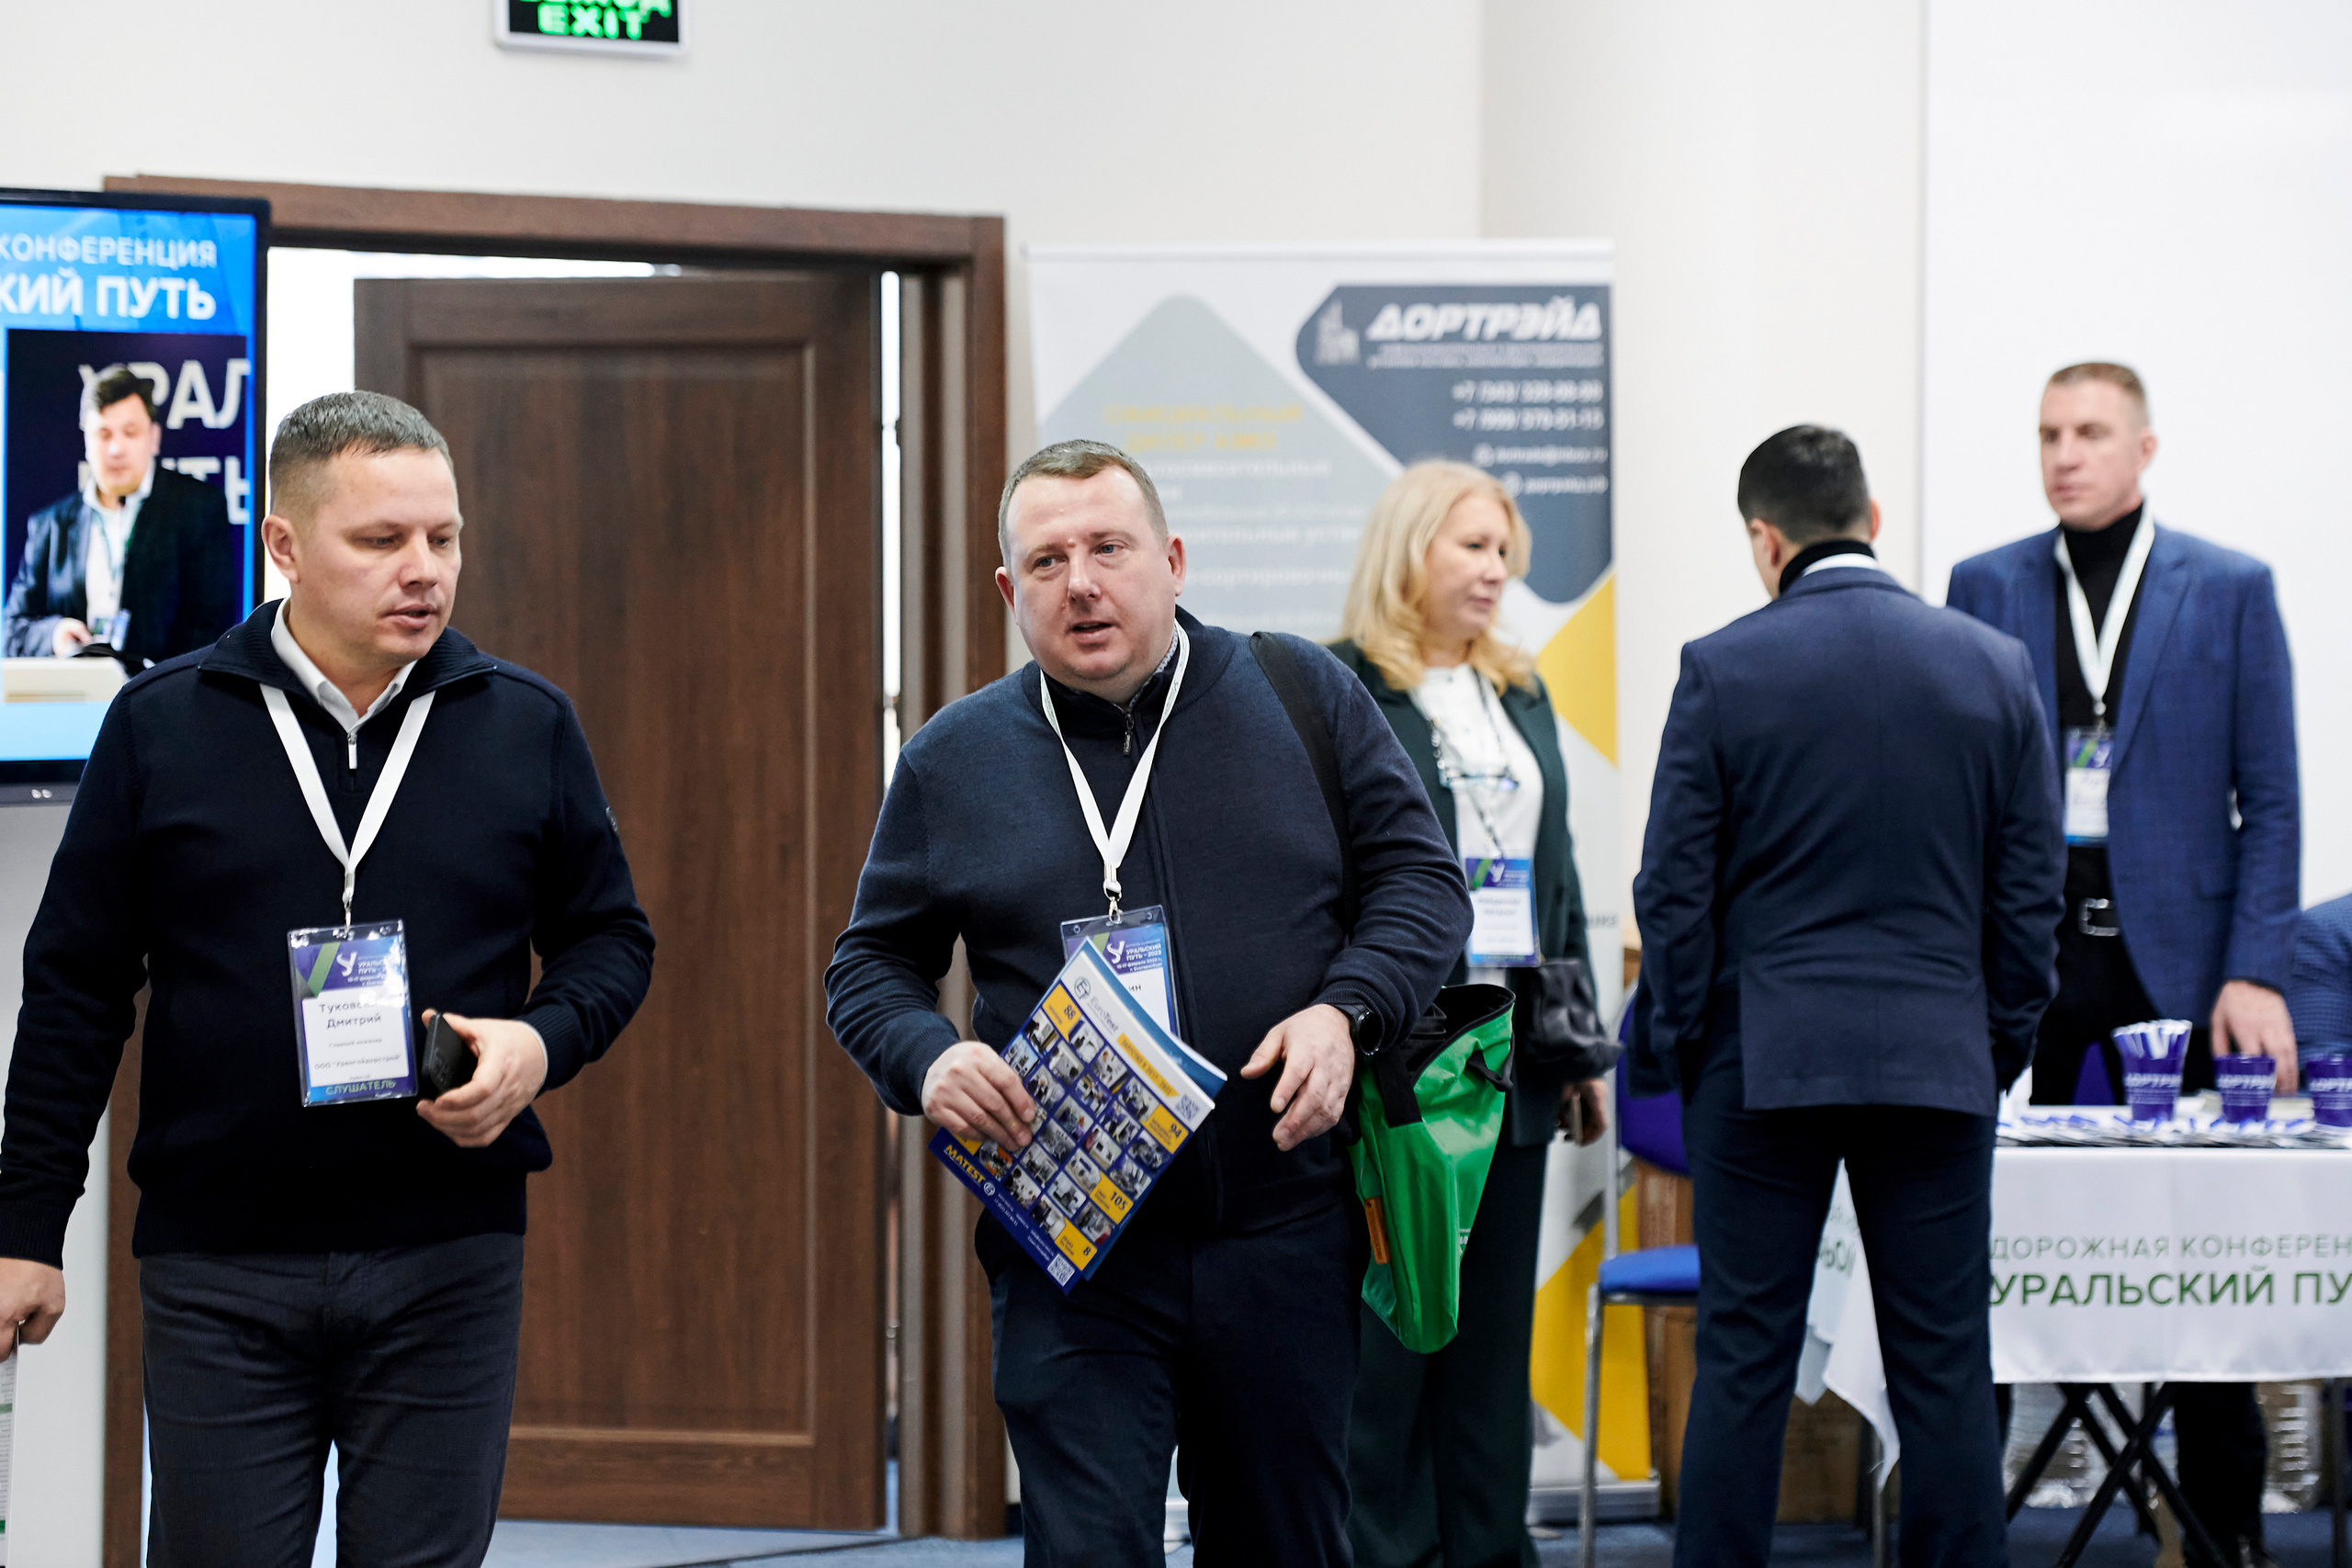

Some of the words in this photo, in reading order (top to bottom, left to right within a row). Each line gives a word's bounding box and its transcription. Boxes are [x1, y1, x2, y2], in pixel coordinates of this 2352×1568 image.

[537, 2, 642, 39] EXIT
[96, 275, 217, 320] ПУТЬ
[1365, 294, 1603, 341] ДОРТРЭЙД
[1125, 942, 1161, 955] УРАЛЬСКИЙ
[1126, 953, 1143, 962] ПУТЬ
[326, 1013, 382, 1030] Дмитрий
[1063, 1004, 1078, 1021] 88
[1091, 996, 1119, 1032] EuroTest
[325, 1078, 397, 1096] СЛУШАТЕЛЬ
[1170, 1122, 1182, 1139] 94
[944, 1144, 986, 1185] MATEST
[1109, 1191, 1128, 1212] 105
[1082, 1246, 1092, 1258] 8
[1990, 1235, 2170, 1262] ДОРОЖНАЯ
[1989, 1264, 2276, 1306] УРАЛЬСКИЙ
[2293, 1270, 2352, 1305] ПУ
